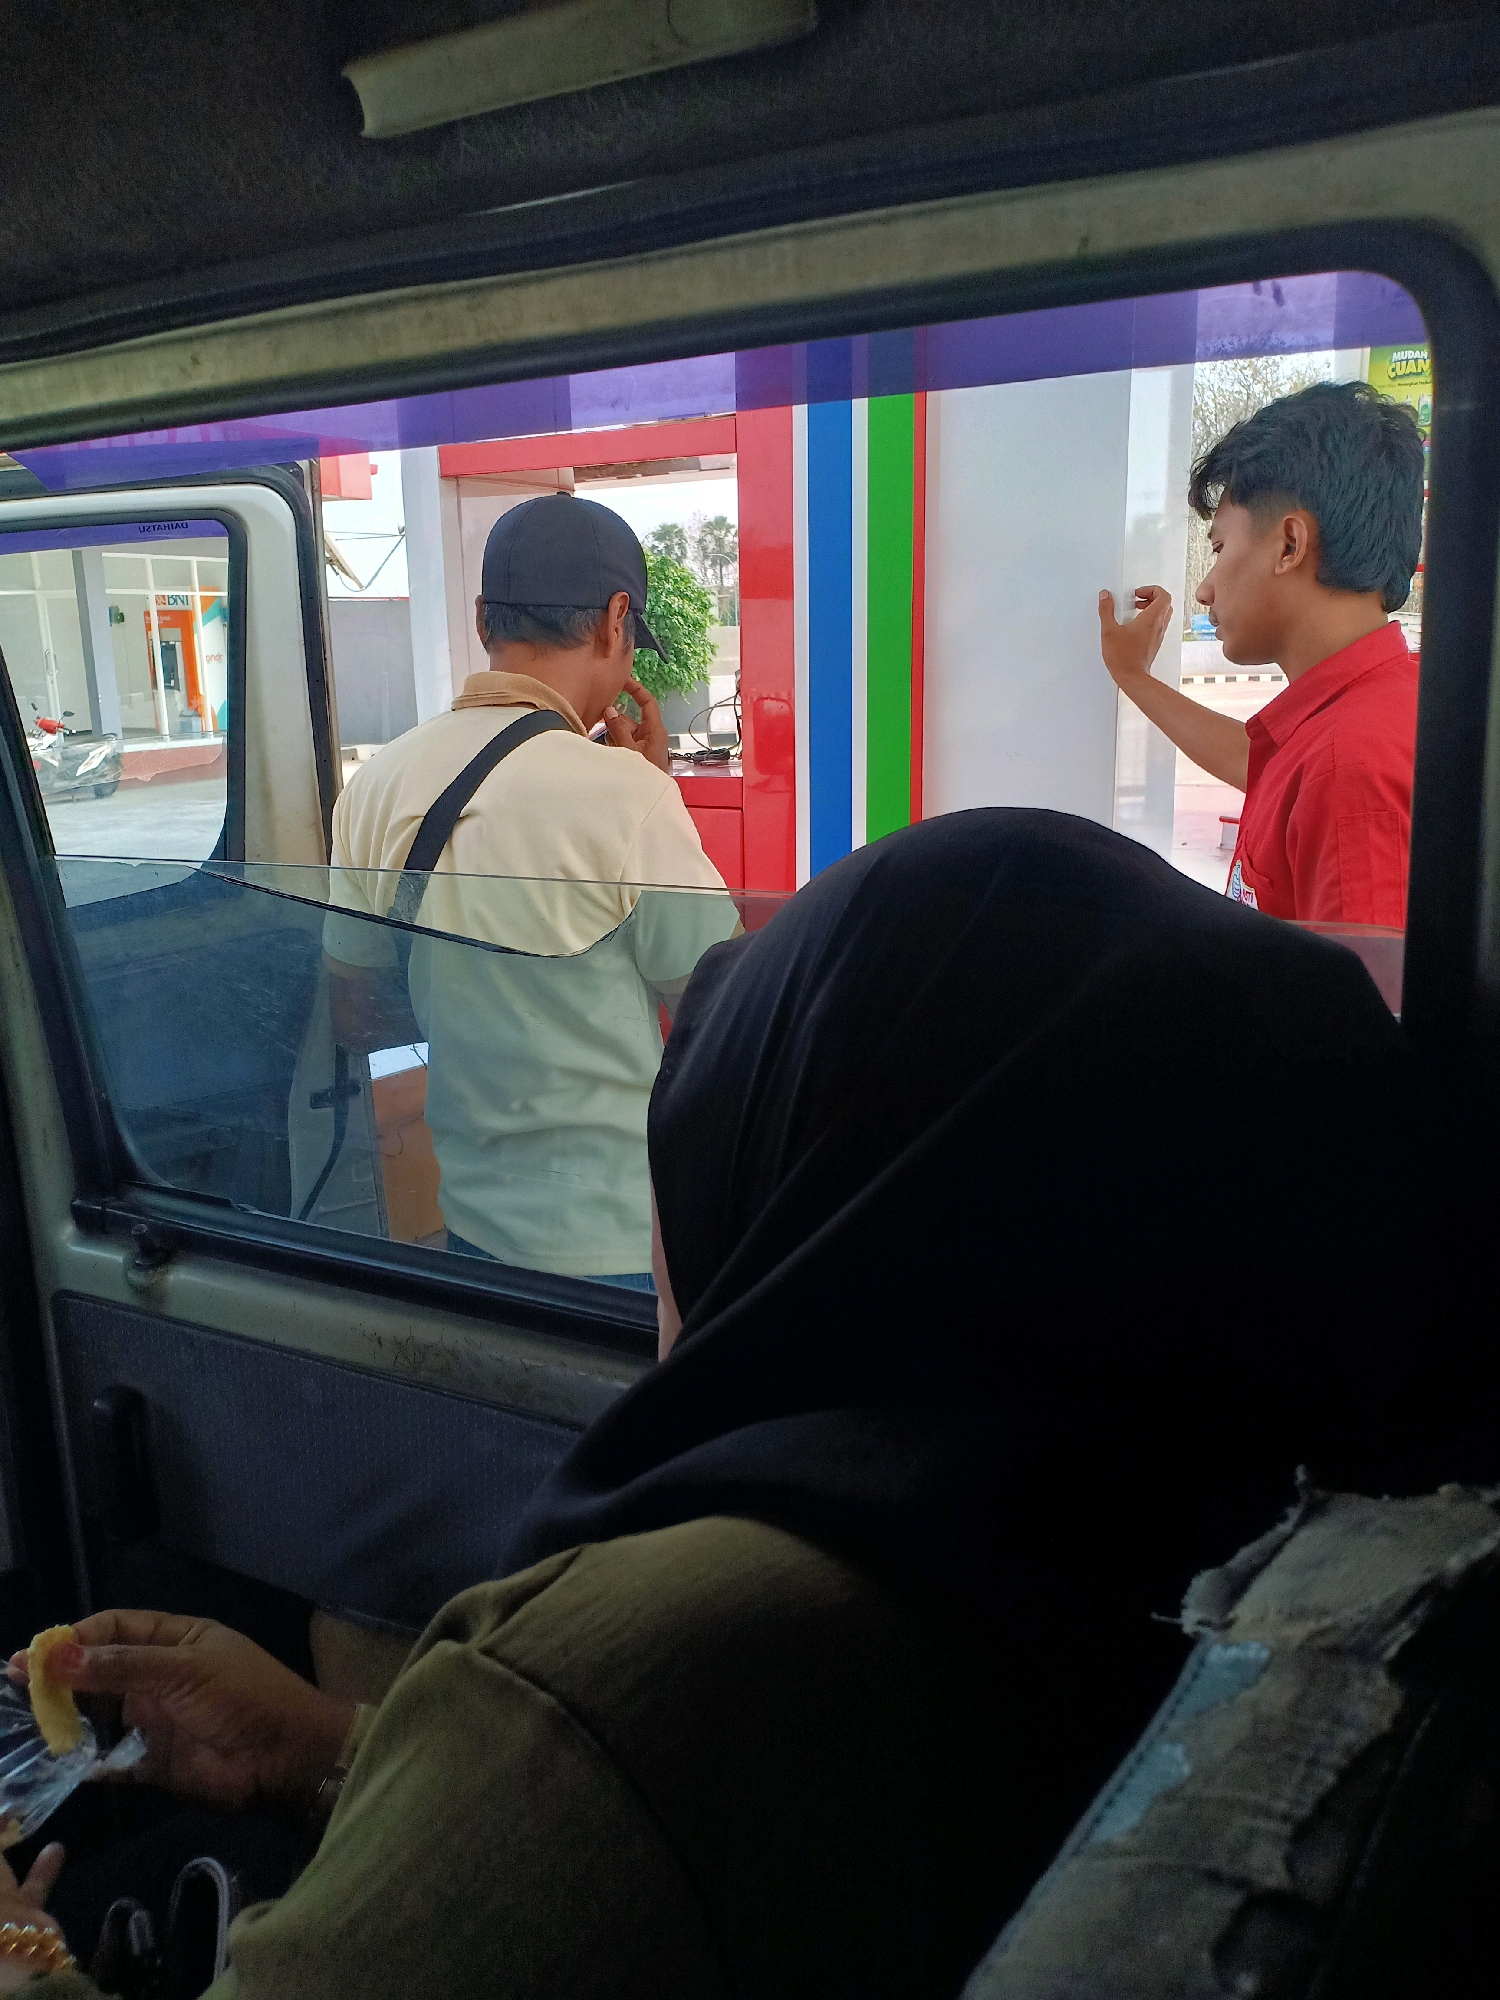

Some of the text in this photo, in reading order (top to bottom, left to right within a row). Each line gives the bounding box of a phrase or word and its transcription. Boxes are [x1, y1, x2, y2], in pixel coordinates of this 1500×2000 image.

[1392, 350, 1428, 362] MUDAH
[1388, 359, 1432, 379] CUAN
[167, 595, 189, 605] BNI
